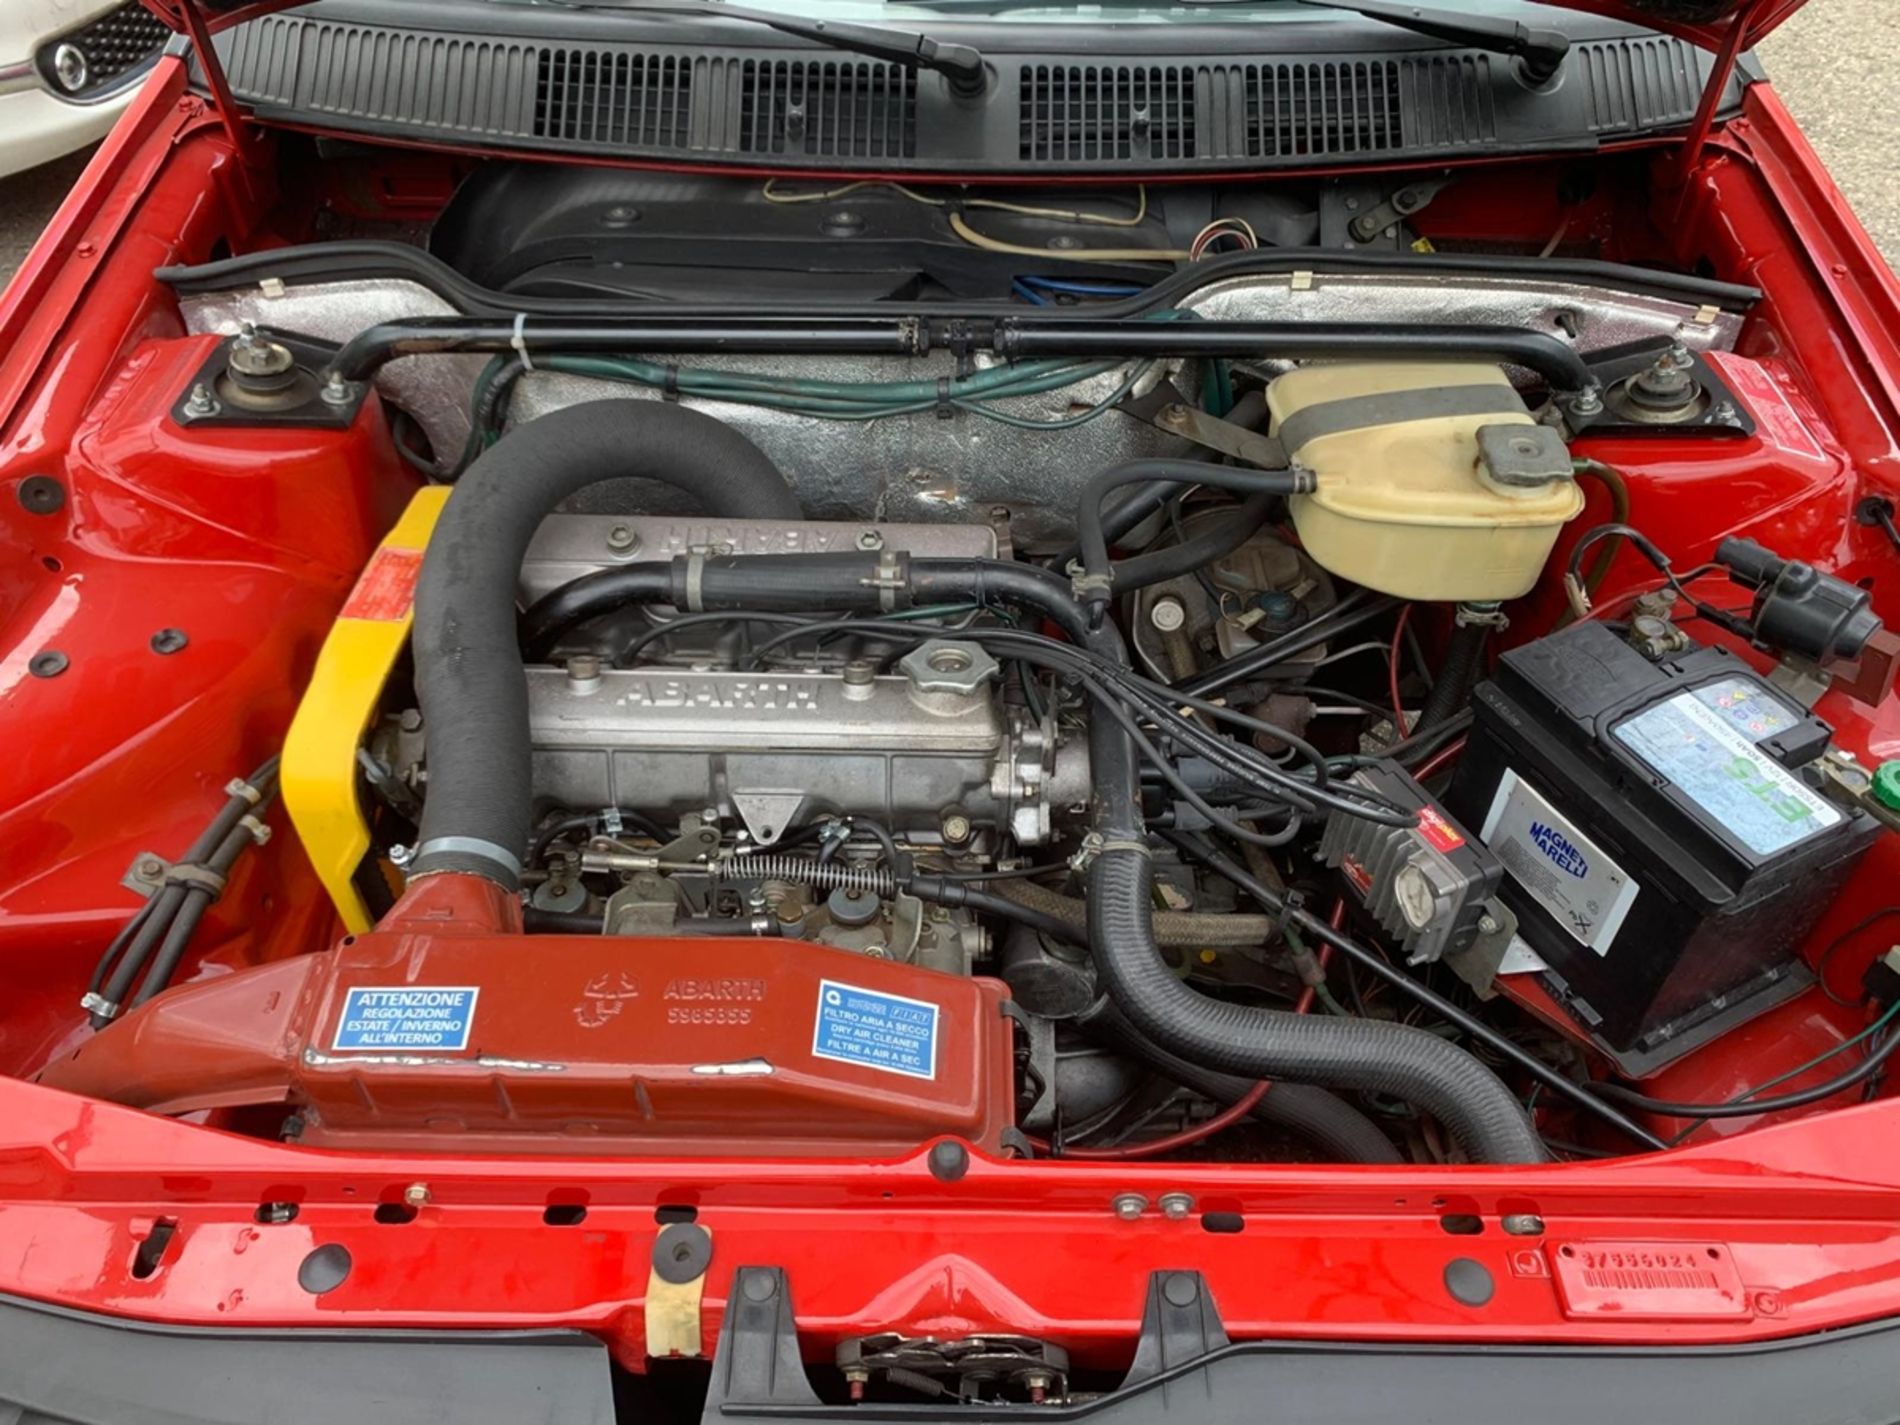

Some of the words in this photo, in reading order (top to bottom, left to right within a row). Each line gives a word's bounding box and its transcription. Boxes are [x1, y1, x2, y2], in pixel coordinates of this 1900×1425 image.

[615, 681, 822, 710] ABARTH
[1721, 756, 1814, 823] ETS
[1530, 821, 1588, 874] MAGNETI
[1530, 828, 1587, 879] MARELLI
[357, 992, 465, 1006] ATTENZIONE
[663, 978, 766, 1001] ABARTH
[346, 1020, 390, 1031] ESTATE
[401, 1020, 462, 1032] INVERNO
[362, 1008, 452, 1019] REGOLAZIONE
[824, 1007, 859, 1021] FILTRO
[860, 1015, 884, 1027] ARIA
[886, 1020, 894, 1029] A
[895, 1022, 929, 1037] SECCO
[892, 1006, 930, 1023] FIAT
[358, 1032, 442, 1044] ALL'INTERNO
[830, 1024, 852, 1035] DRY
[853, 1028, 871, 1040] AIR
[873, 1032, 919, 1049] CLEANER
[827, 1039, 861, 1054] FILTRE
[863, 1047, 871, 1055] A
[872, 1048, 889, 1059] AIR
[890, 1052, 899, 1061] A
[900, 1054, 921, 1066] SEC
